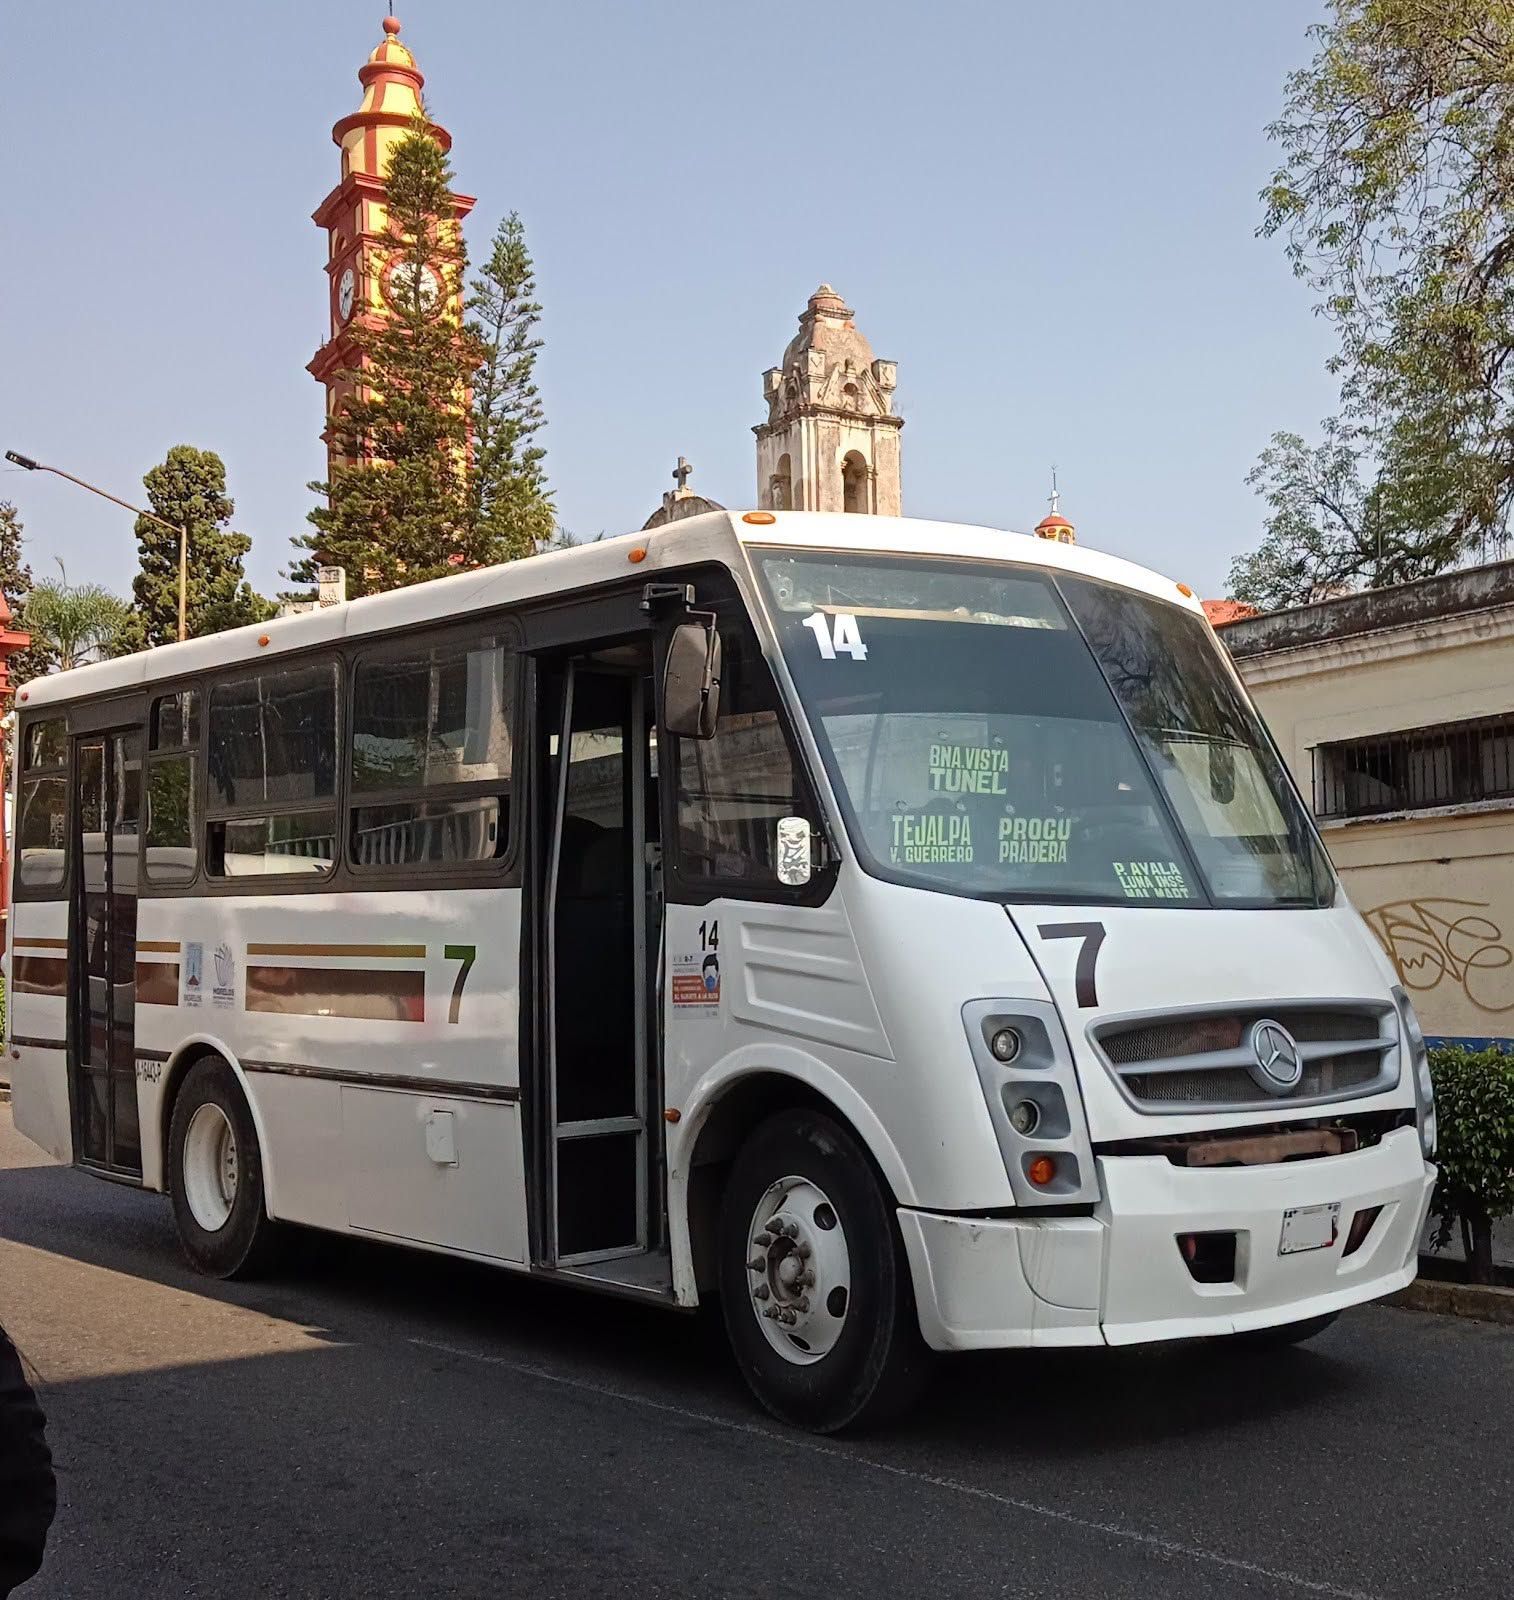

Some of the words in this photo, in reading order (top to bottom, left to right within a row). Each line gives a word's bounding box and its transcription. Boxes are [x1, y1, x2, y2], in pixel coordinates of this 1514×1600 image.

[802, 612, 868, 661] 14
[929, 767, 1008, 795] TUNEL
[892, 814, 971, 847] TEJALPA
[889, 846, 901, 863] V.
[905, 845, 974, 863] GUERRERO
[998, 840, 1067, 863] PRADERA
[1112, 861, 1128, 876] P.
[1129, 861, 1181, 876] AYALA
[1118, 875, 1155, 889] LUNA
[698, 920, 719, 951] 14
[1037, 922, 1107, 1008] 7
[444, 945, 476, 1024] 7
